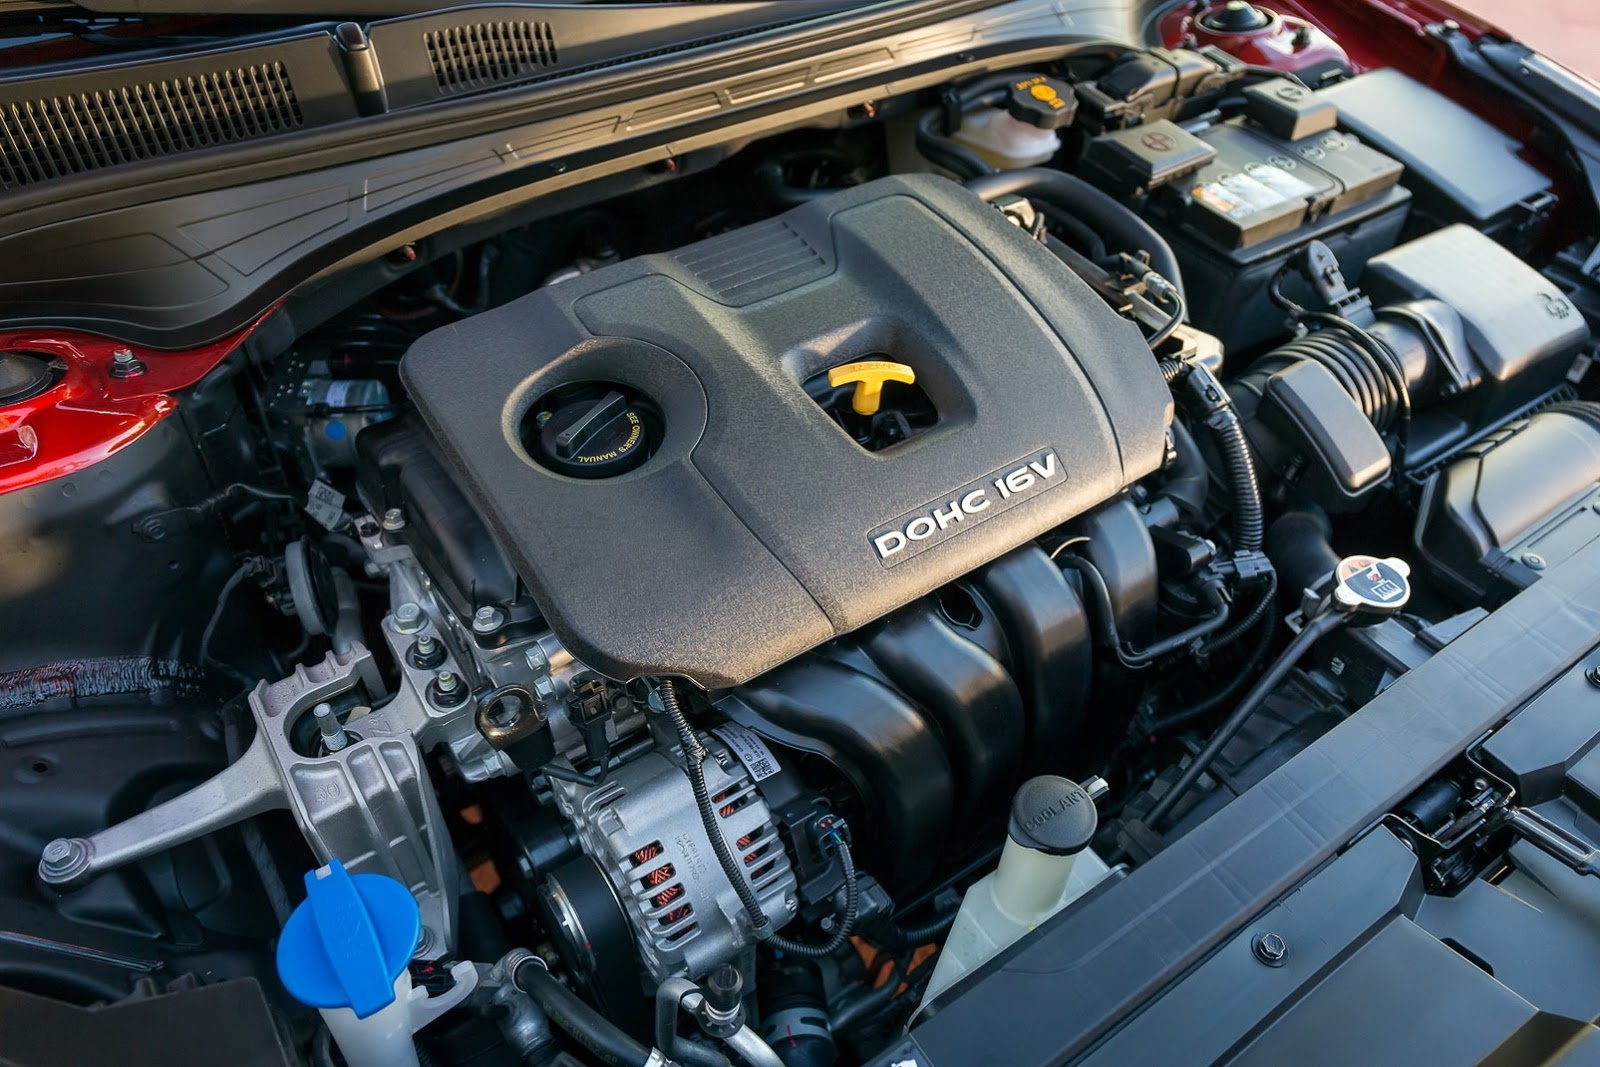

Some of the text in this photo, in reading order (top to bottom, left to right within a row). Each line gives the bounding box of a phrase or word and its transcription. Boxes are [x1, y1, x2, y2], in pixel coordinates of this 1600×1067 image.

[577, 412, 641, 463] SEE OWNER'S MANUAL
[873, 453, 1056, 559] DOHC 16V
[1024, 790, 1085, 831] COOLANT
